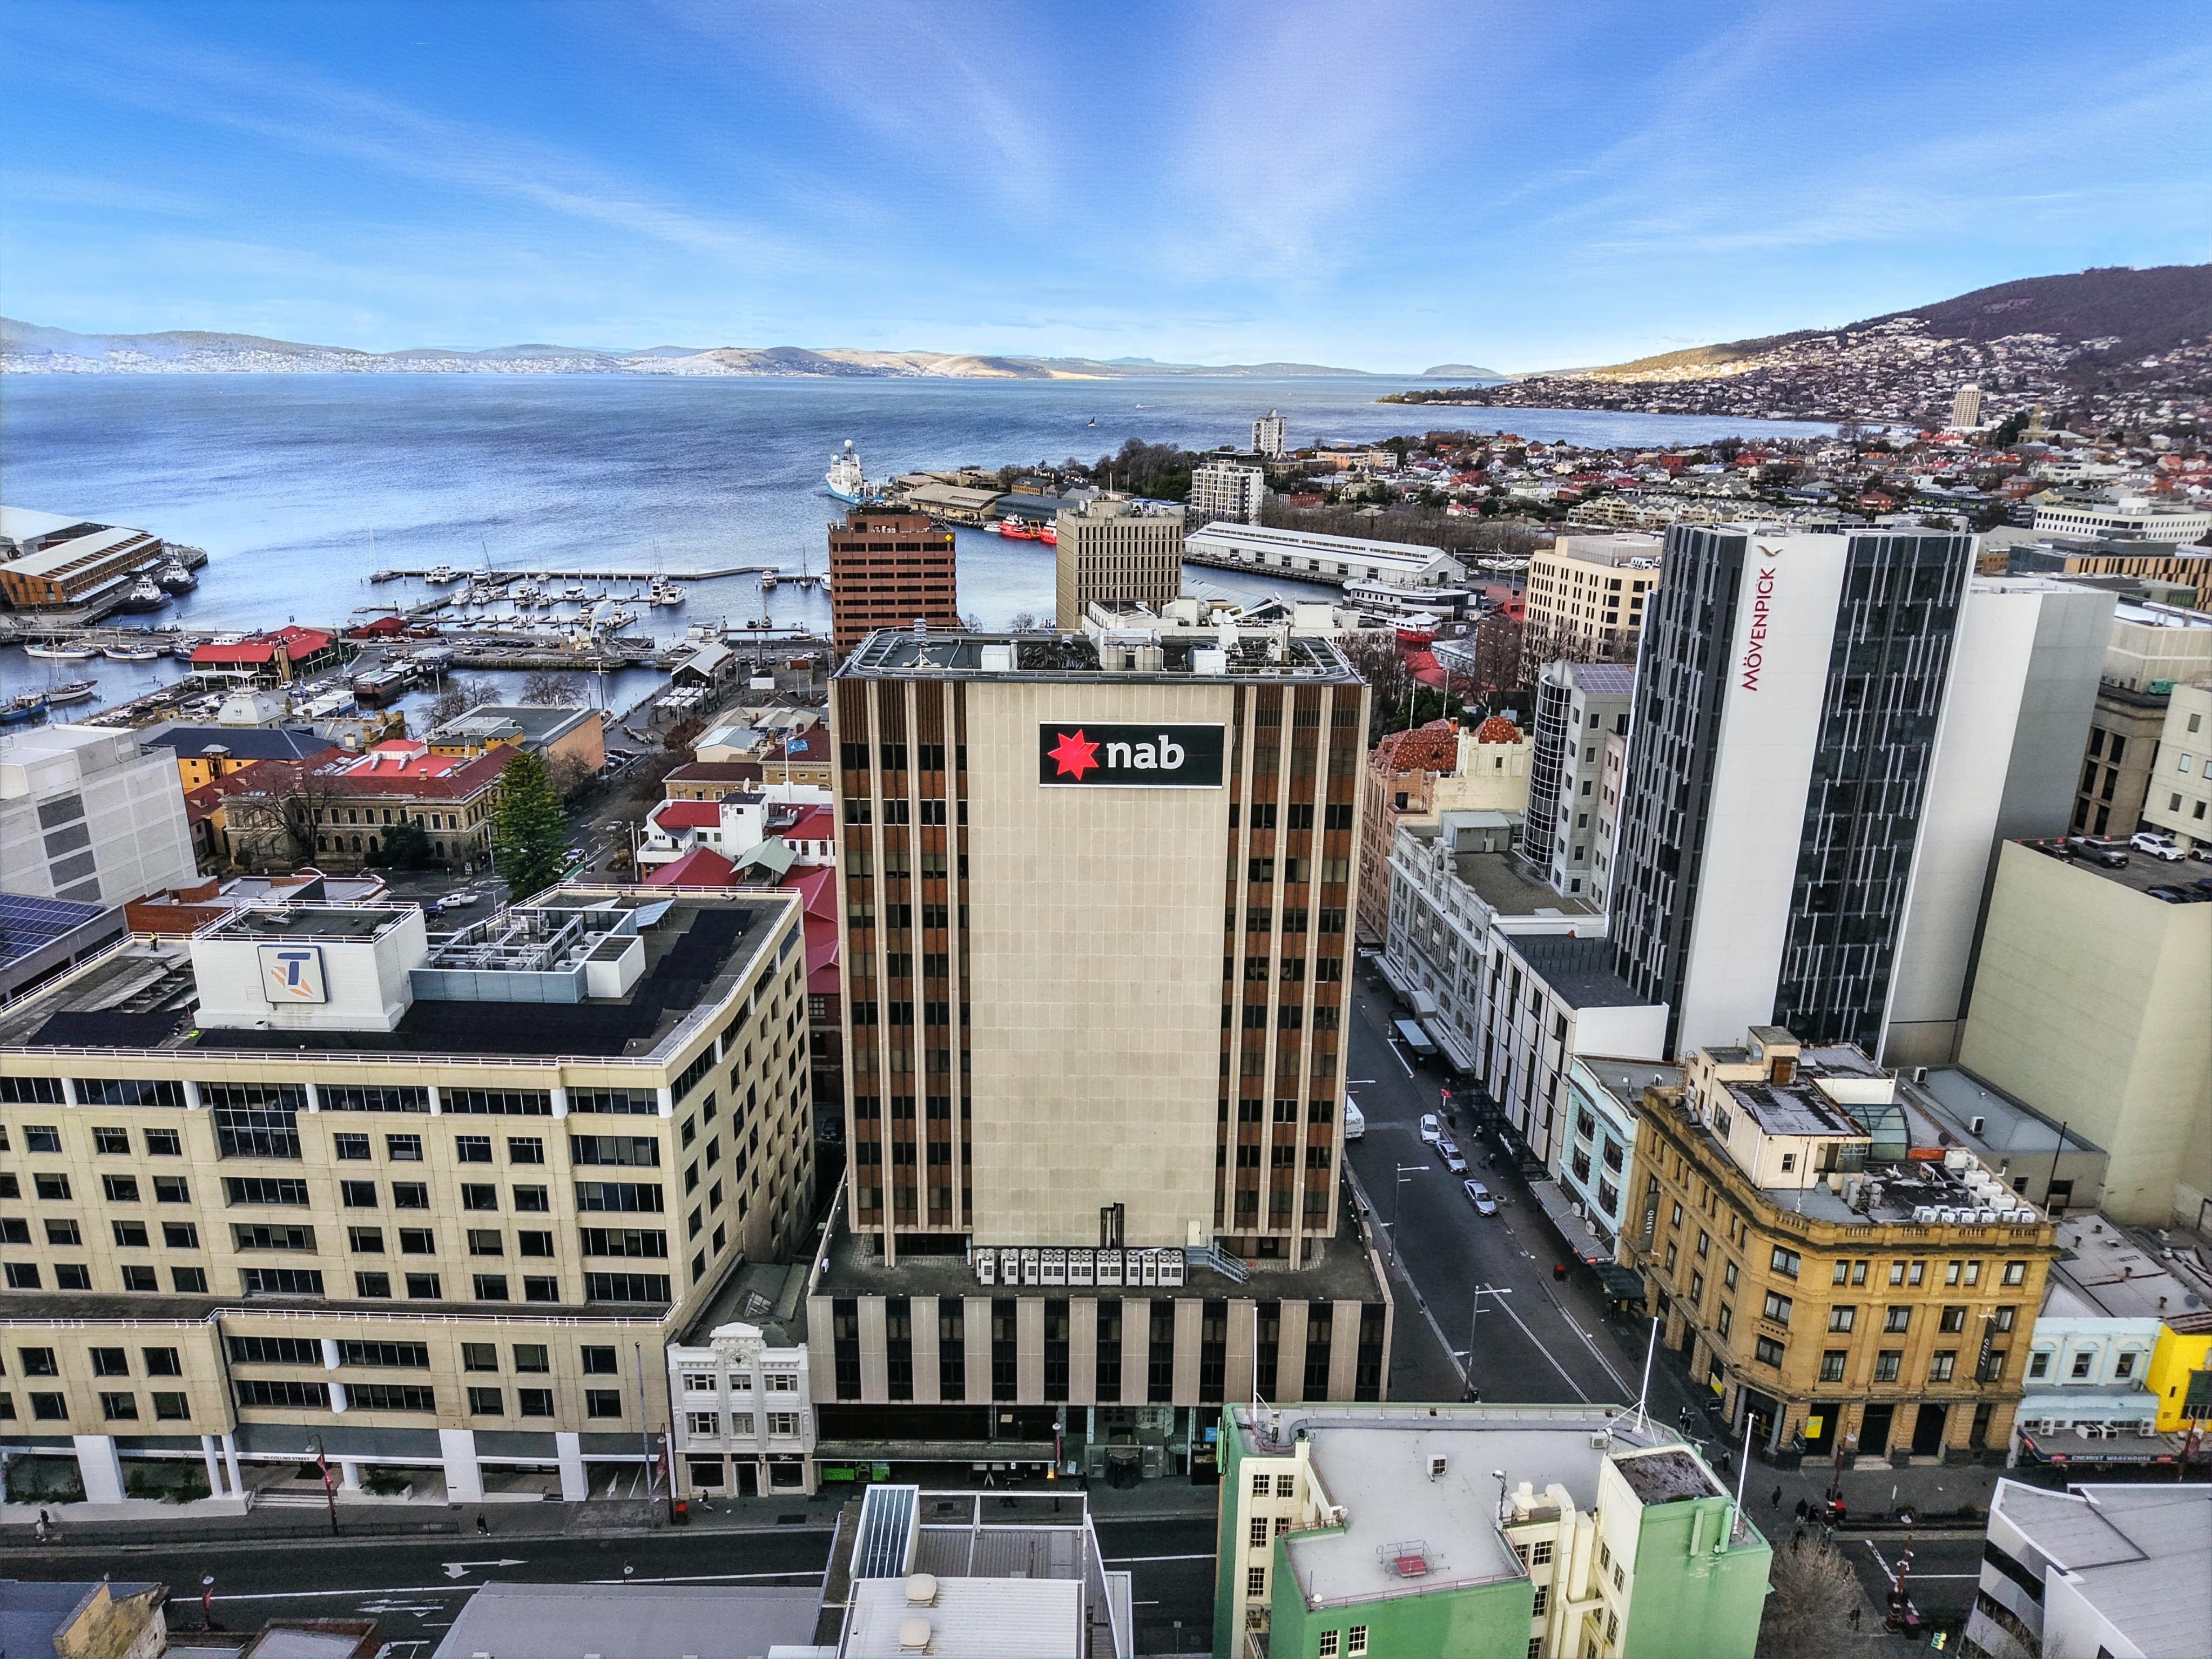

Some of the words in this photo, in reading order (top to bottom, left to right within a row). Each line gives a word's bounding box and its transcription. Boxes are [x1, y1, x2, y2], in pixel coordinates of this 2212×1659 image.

[1741, 567, 1776, 691] MÖVENPICK
[1106, 734, 1185, 770] nab
[277, 952, 311, 986] T
[1645, 1210, 1654, 1235] QUEST
[1979, 1338, 1990, 1366] QUEST
